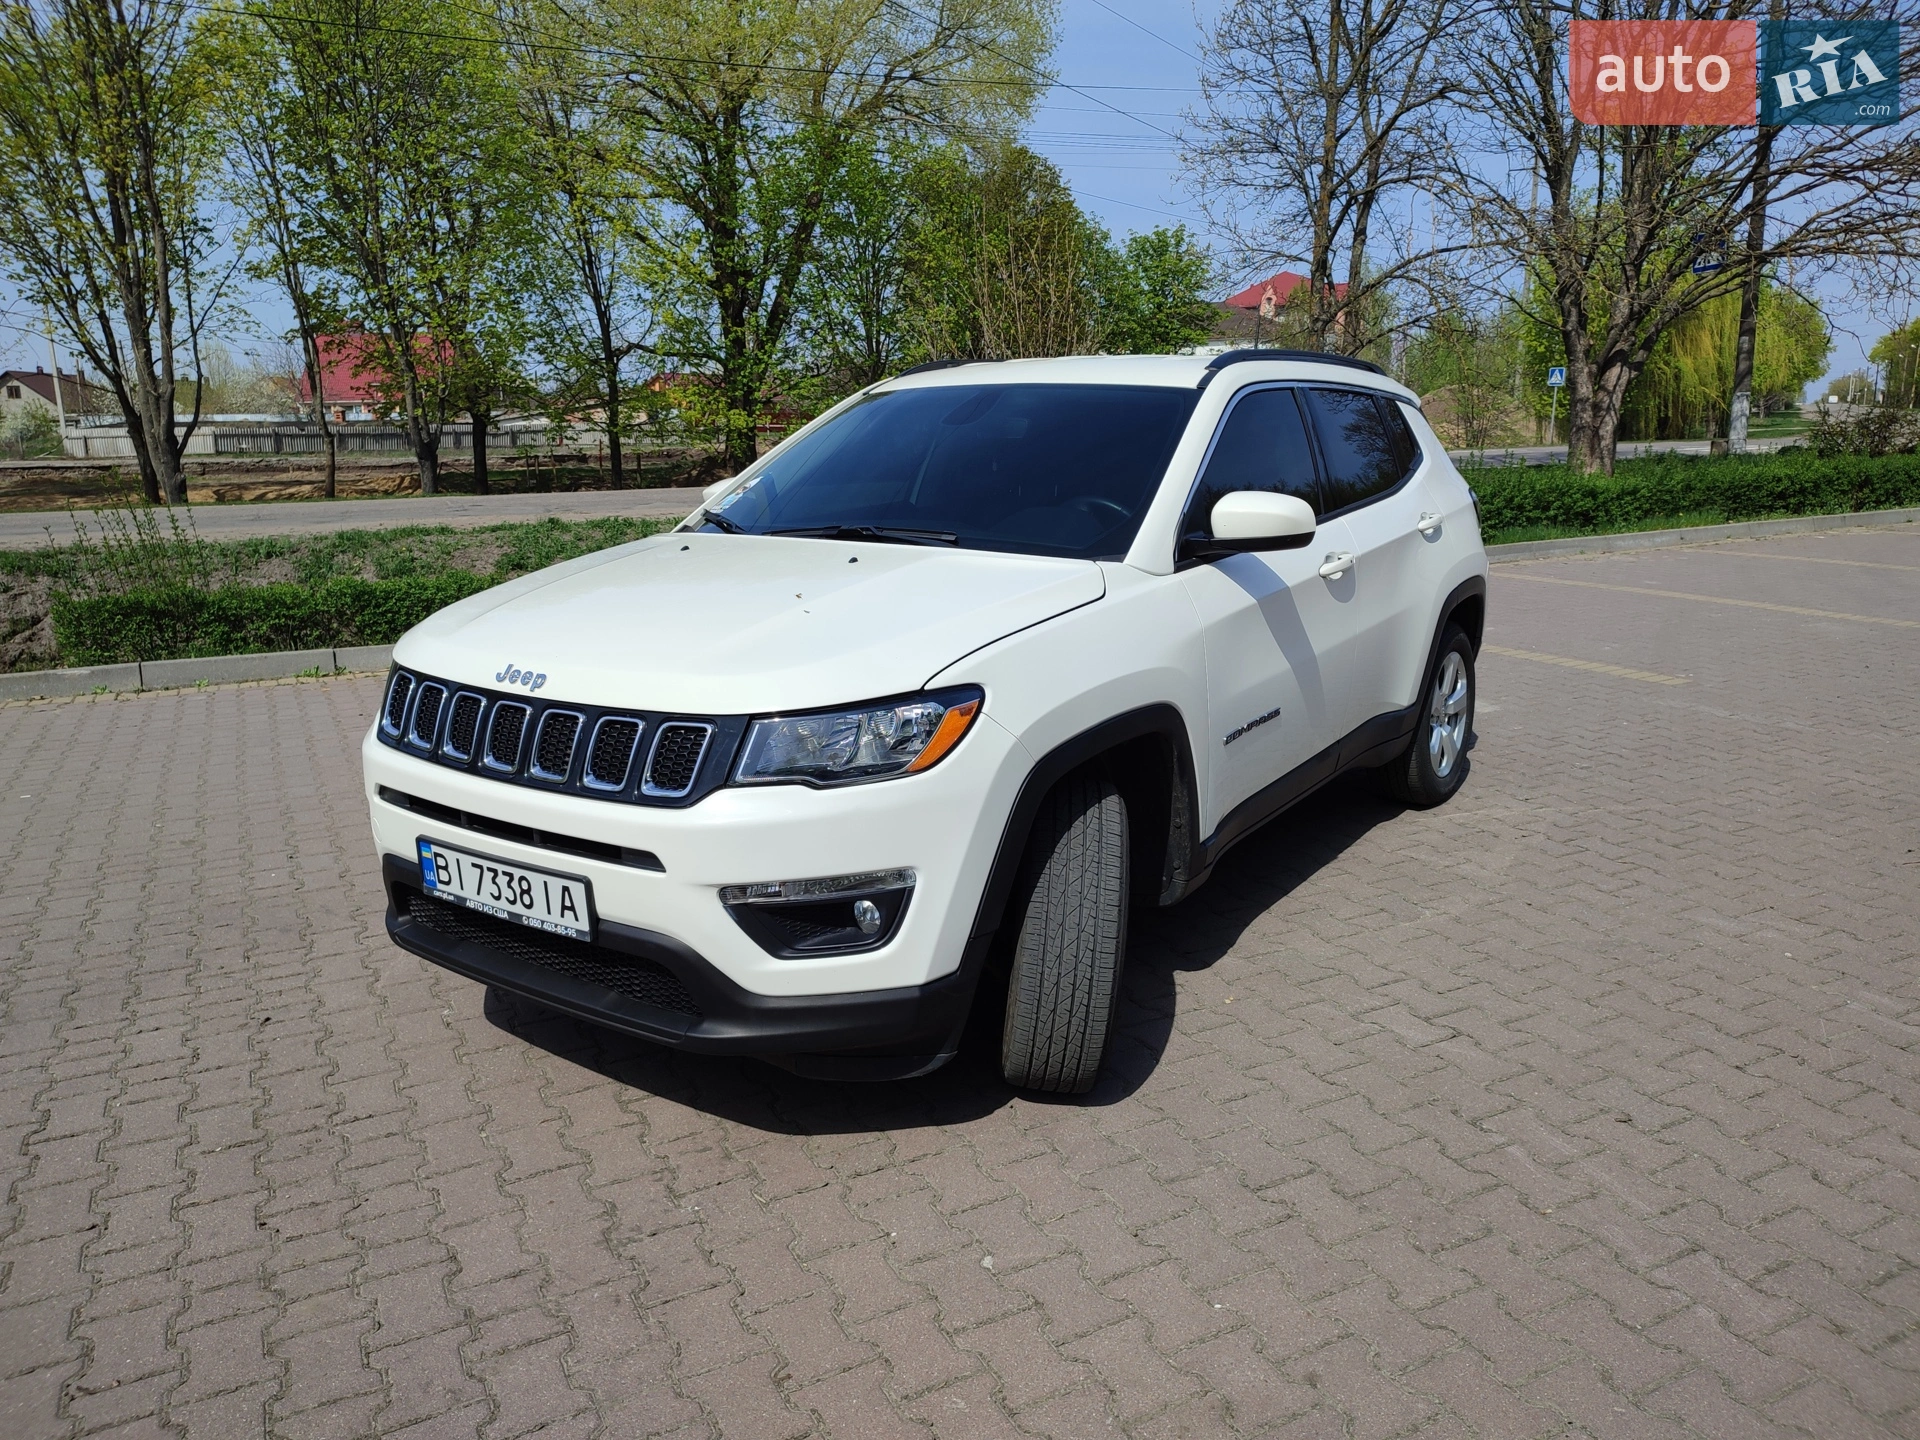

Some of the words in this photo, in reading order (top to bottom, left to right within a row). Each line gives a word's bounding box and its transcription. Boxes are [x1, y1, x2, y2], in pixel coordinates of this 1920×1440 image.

[495, 663, 547, 692] Jeep
[425, 869, 436, 881] UA
[434, 851, 464, 891] BI
[471, 862, 534, 910] 7338
[544, 880, 579, 922] IA
[466, 899, 483, 910] АВТО
[484, 905, 493, 914] ИЗ
[493, 908, 509, 919] США
